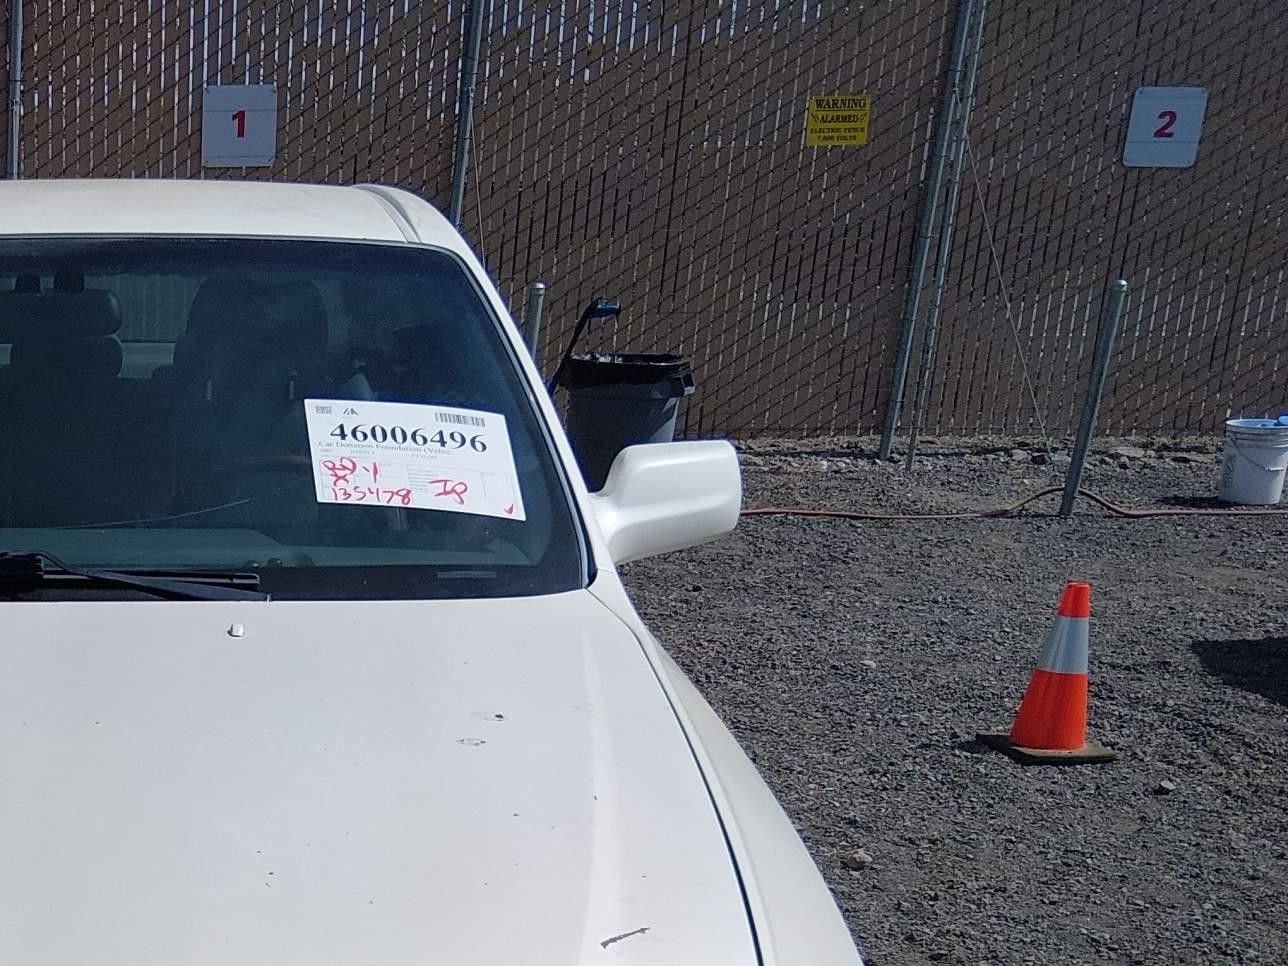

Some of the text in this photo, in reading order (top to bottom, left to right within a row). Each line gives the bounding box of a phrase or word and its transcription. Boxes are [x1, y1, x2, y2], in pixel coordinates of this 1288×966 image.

[815, 98, 866, 109] WARNING
[231, 110, 246, 138] 1
[820, 114, 859, 123] ALARMED
[1153, 110, 1177, 138] 2
[330, 423, 487, 453] 46006496
[336, 441, 374, 449] Donation
[375, 444, 422, 453] Foundation
